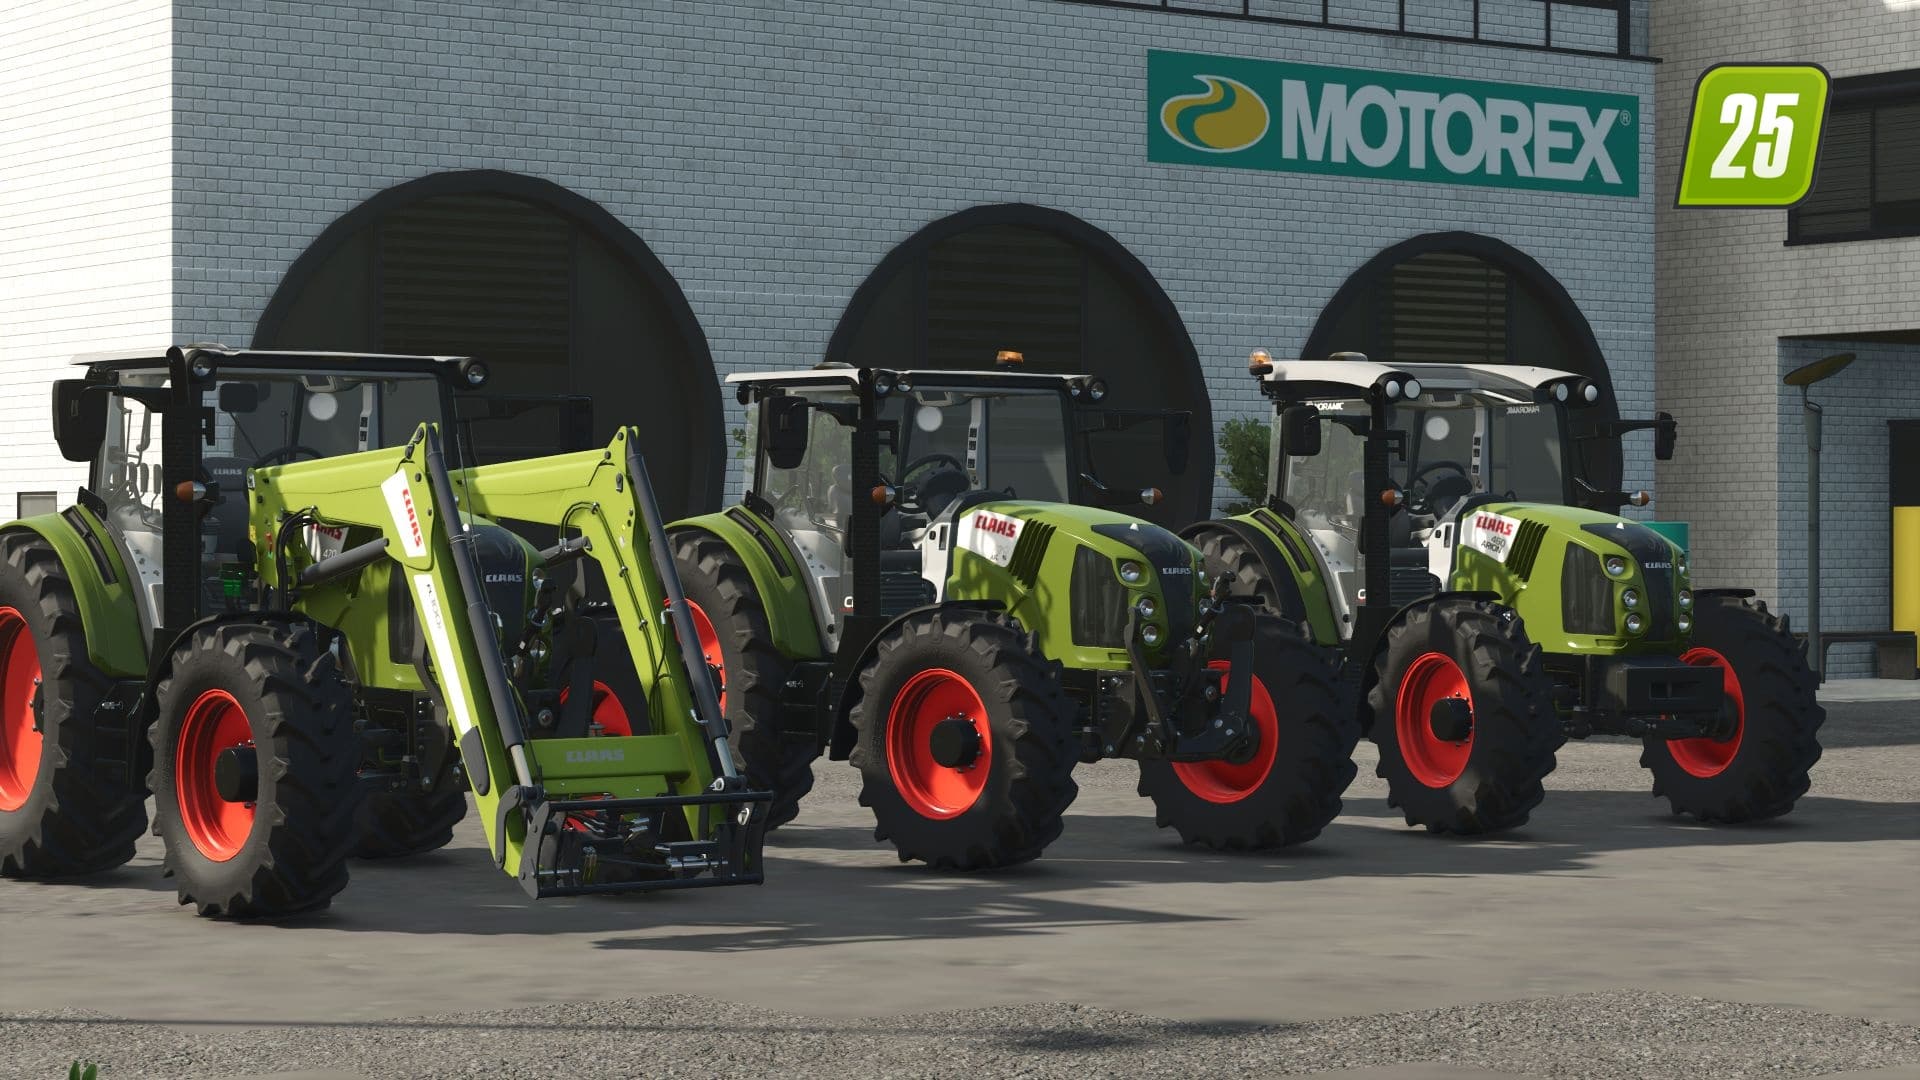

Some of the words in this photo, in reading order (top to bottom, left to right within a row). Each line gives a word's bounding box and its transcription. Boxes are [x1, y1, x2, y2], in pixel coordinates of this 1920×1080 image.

[402, 488, 423, 548] CLAAS
[975, 515, 1017, 538] CLAAS
[1476, 515, 1514, 536] CLAAS
[1481, 540, 1504, 554] ARION
[485, 574, 523, 583] CLAAS
[565, 749, 625, 763] CLAAS
